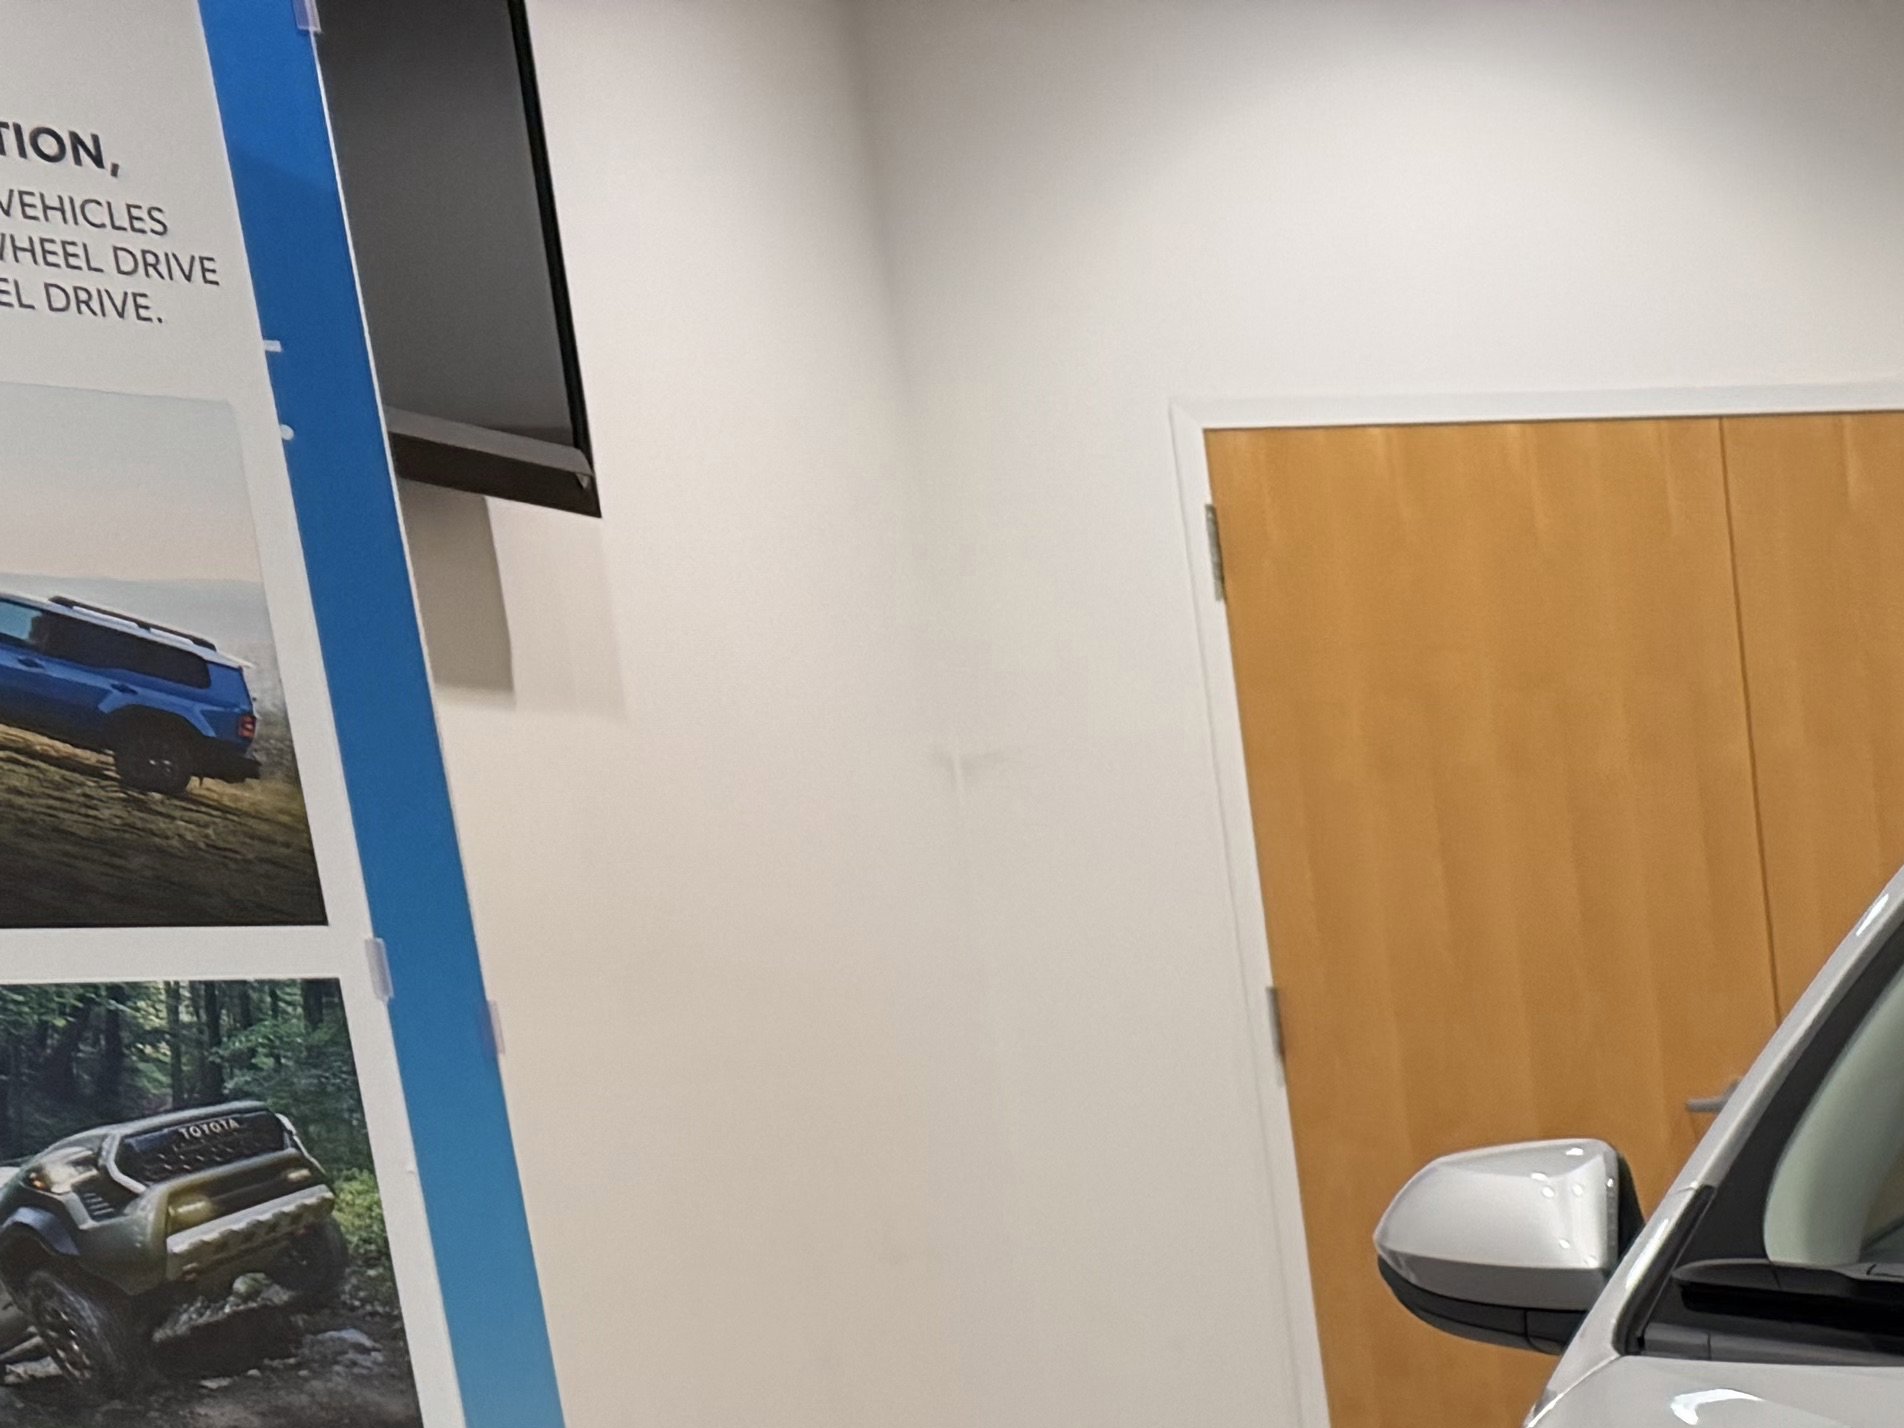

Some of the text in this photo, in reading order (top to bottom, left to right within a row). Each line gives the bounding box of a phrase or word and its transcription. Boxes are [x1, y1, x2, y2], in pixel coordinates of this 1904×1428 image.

[0, 232, 220, 286] HEEL DRIVE
[44, 282, 163, 324] DRIVE.
[177, 1118, 240, 1140] TOYOTA
